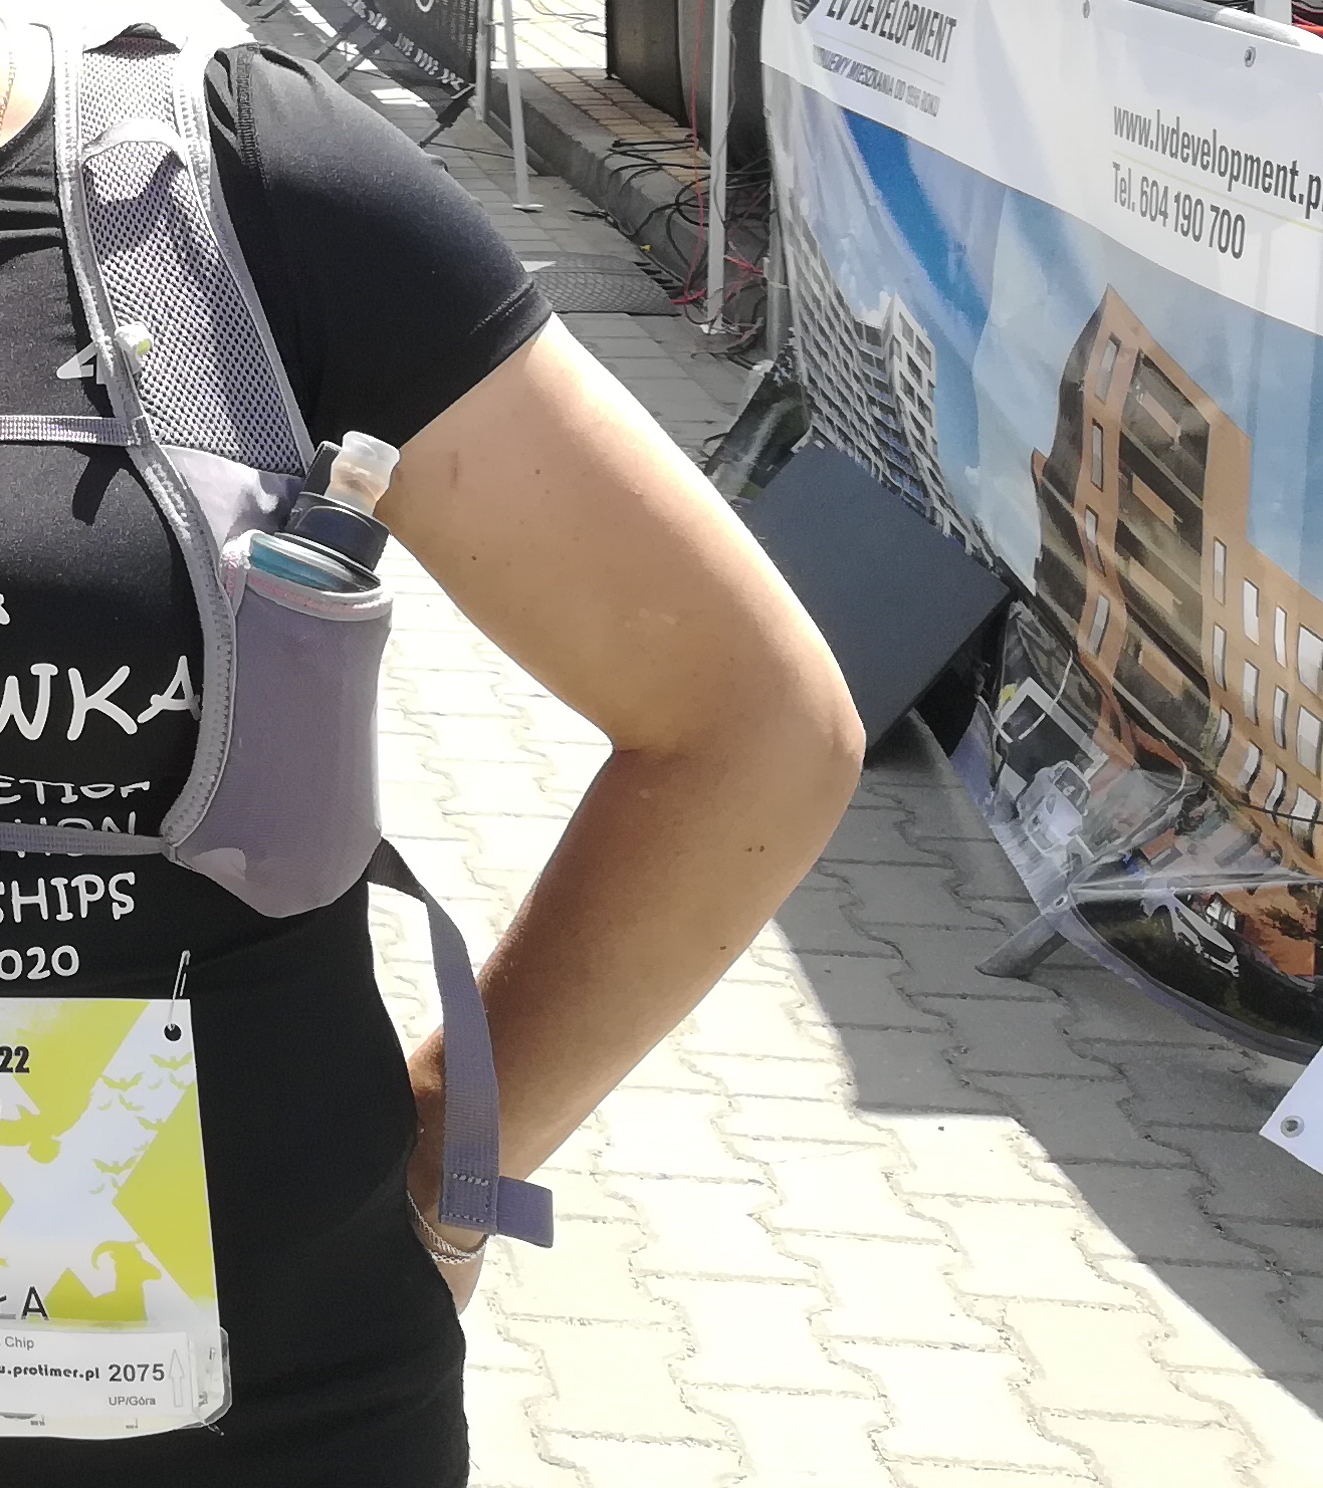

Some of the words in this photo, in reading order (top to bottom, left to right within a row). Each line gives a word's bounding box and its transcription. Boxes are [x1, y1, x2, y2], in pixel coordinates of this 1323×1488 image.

[1114, 105, 1323, 220] www.lvdevelopment.p
[1112, 161, 1136, 213] Tel.
[1140, 176, 1169, 228] 604
[1174, 190, 1205, 243] 190
[1208, 203, 1246, 260] 700
[4, 1335, 35, 1351] Chip
[108, 1362, 166, 1383] 2075
[108, 1396, 157, 1407] UP/Góra
